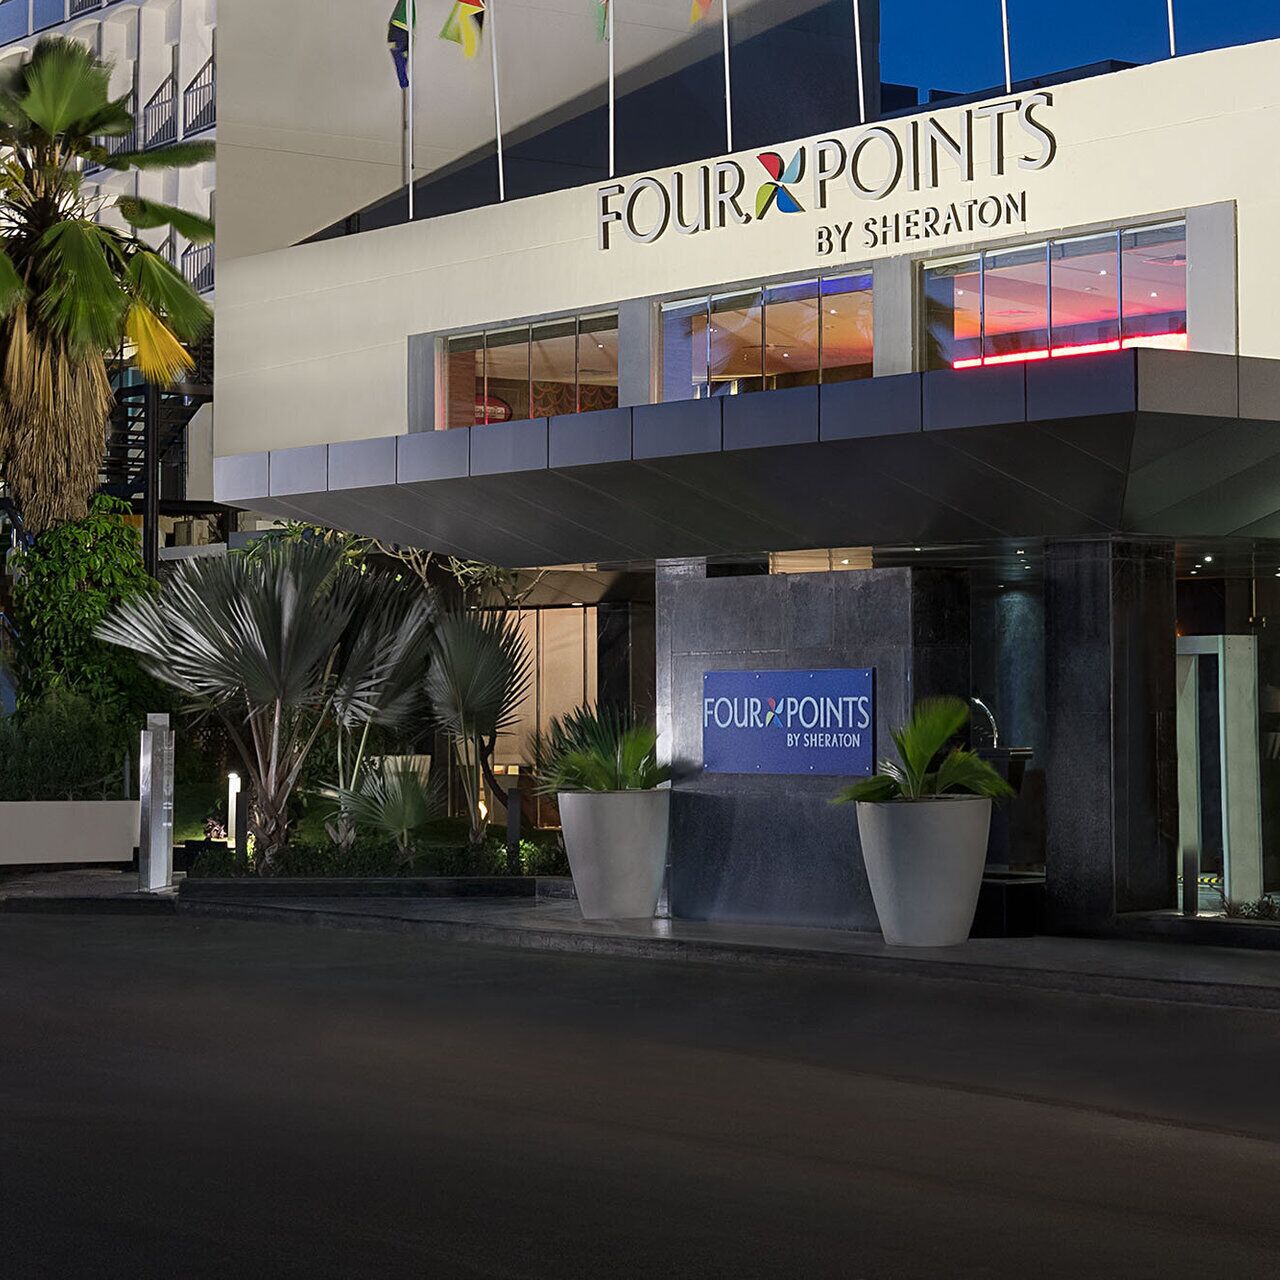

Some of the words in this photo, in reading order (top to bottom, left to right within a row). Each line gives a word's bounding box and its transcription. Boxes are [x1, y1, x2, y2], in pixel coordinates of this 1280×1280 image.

[596, 160, 753, 251] FOUR
[813, 92, 1057, 209] POINTS
[816, 220, 853, 256] BY
[863, 190, 1026, 249] SHERATON
[703, 697, 764, 729] FOUR
[786, 696, 870, 729] POINTS
[787, 733, 802, 747] BY
[803, 733, 860, 748] SHERATON
